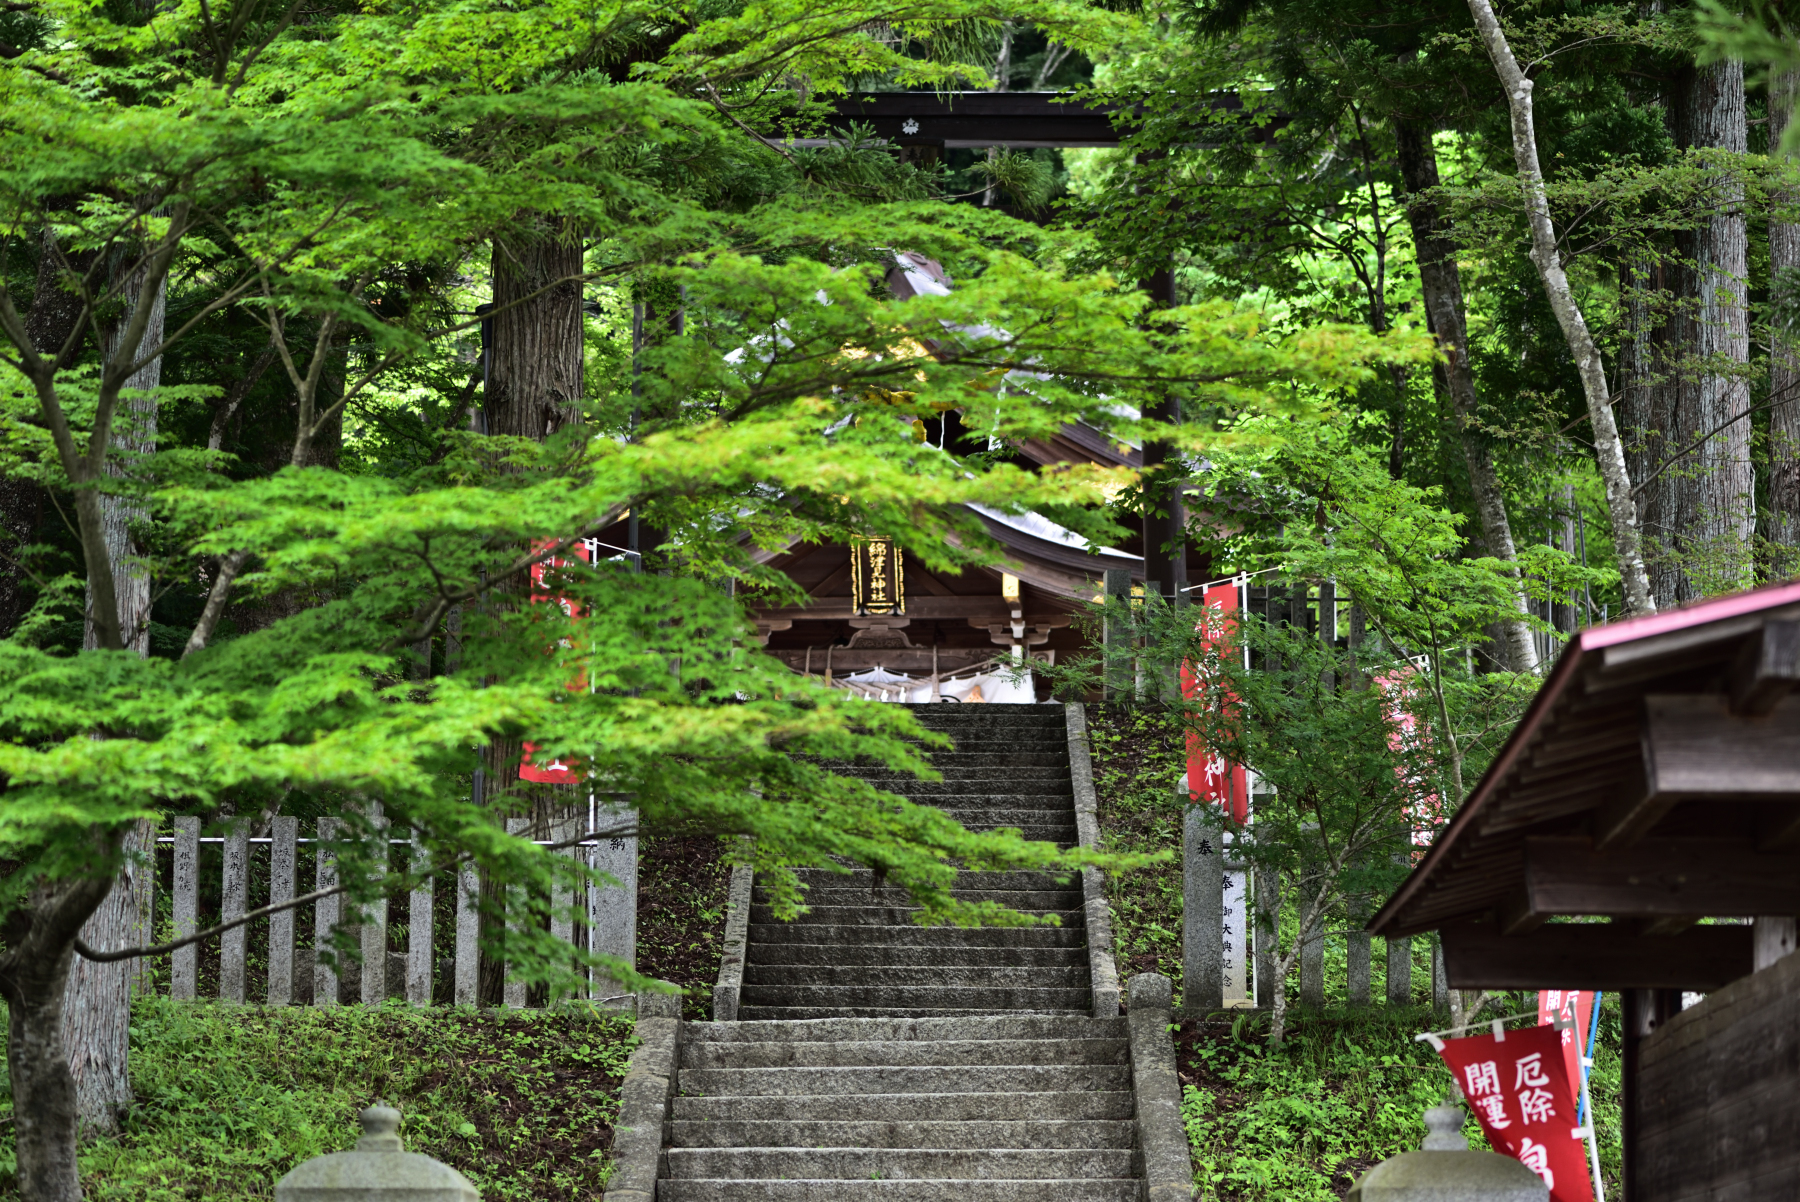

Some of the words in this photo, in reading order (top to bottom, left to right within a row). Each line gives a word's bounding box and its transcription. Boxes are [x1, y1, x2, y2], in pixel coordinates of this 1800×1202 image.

[868, 542, 887, 602] 綿津見神社
[1197, 838, 1214, 856] 奉
[1463, 1060, 1512, 1130] 開運
[1513, 1052, 1556, 1126] 厄除
